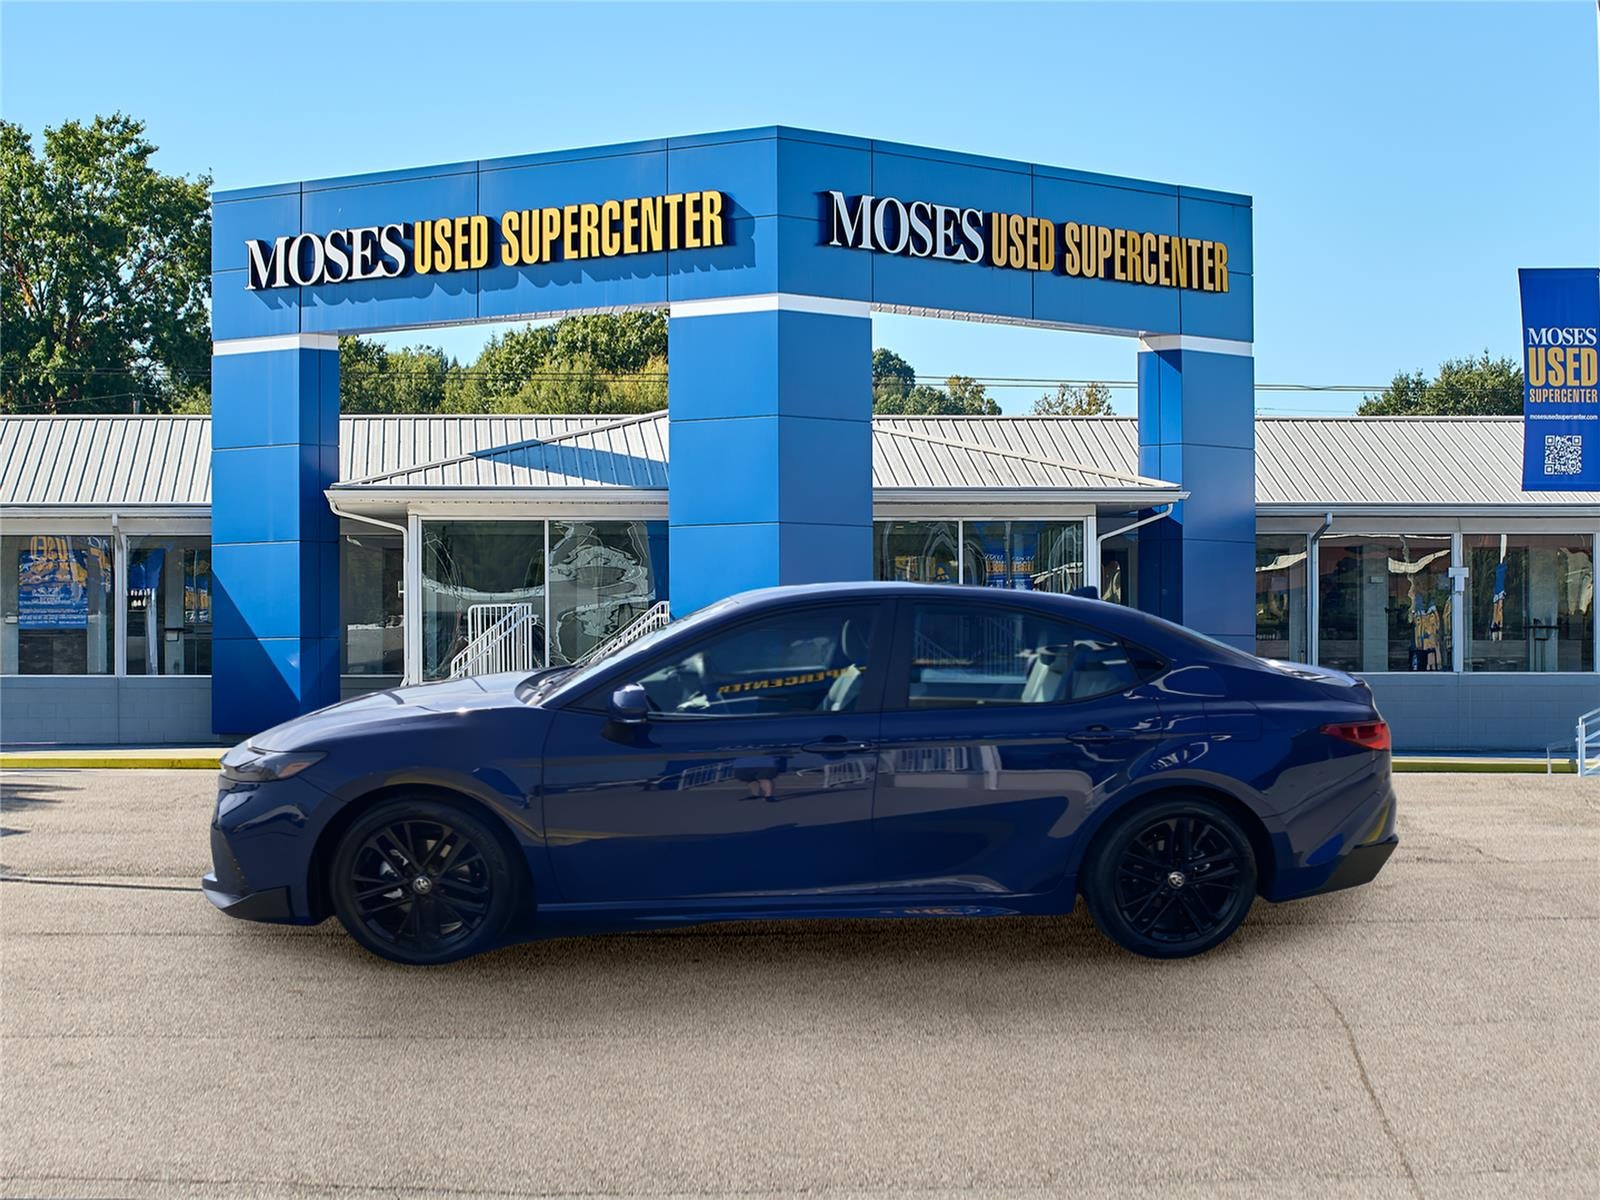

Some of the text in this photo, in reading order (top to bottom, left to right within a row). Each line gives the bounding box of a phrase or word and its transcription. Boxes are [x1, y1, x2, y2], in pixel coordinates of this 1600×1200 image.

[245, 190, 724, 291] MOSES USED SUPERCENTER
[829, 191, 1229, 293] MOSES USED SUPERCENTER
[1528, 328, 1597, 346] MOSES
[1529, 348, 1598, 387] USED
[1529, 388, 1598, 403] SUPERCENTER
